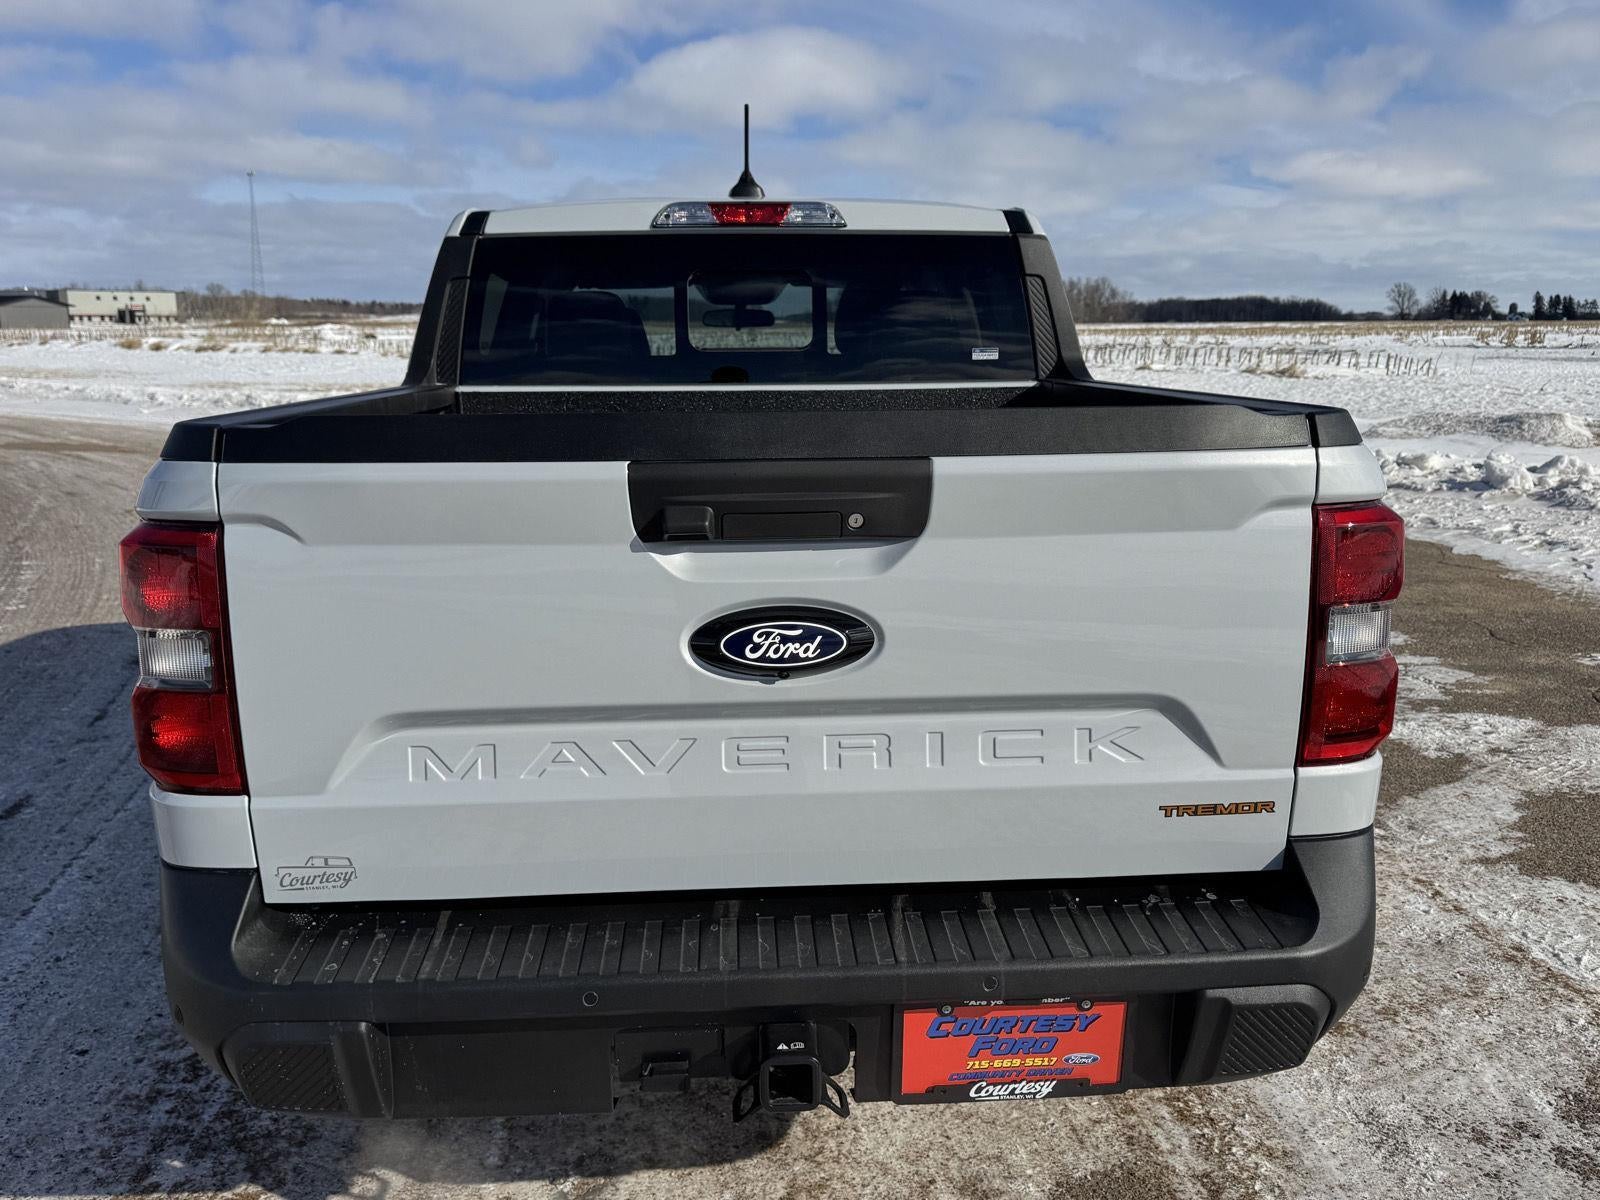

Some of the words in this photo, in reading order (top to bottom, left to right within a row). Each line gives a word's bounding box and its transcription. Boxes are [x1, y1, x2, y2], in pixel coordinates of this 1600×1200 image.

[745, 628, 823, 659] Ford
[407, 726, 1145, 782] MAVERICK
[1159, 801, 1276, 817] TREMOR
[280, 871, 355, 888] Courtesy
[926, 1013, 1102, 1038] COURTESY
[968, 1036, 1059, 1058] FORD
[966, 1057, 1058, 1070] 715-669-5517
[1068, 1055, 1093, 1064] Ford
[948, 1069, 1025, 1081] COMMUNITY
[1026, 1067, 1074, 1077] DRIVEN
[969, 1080, 1057, 1099] Courtesy
